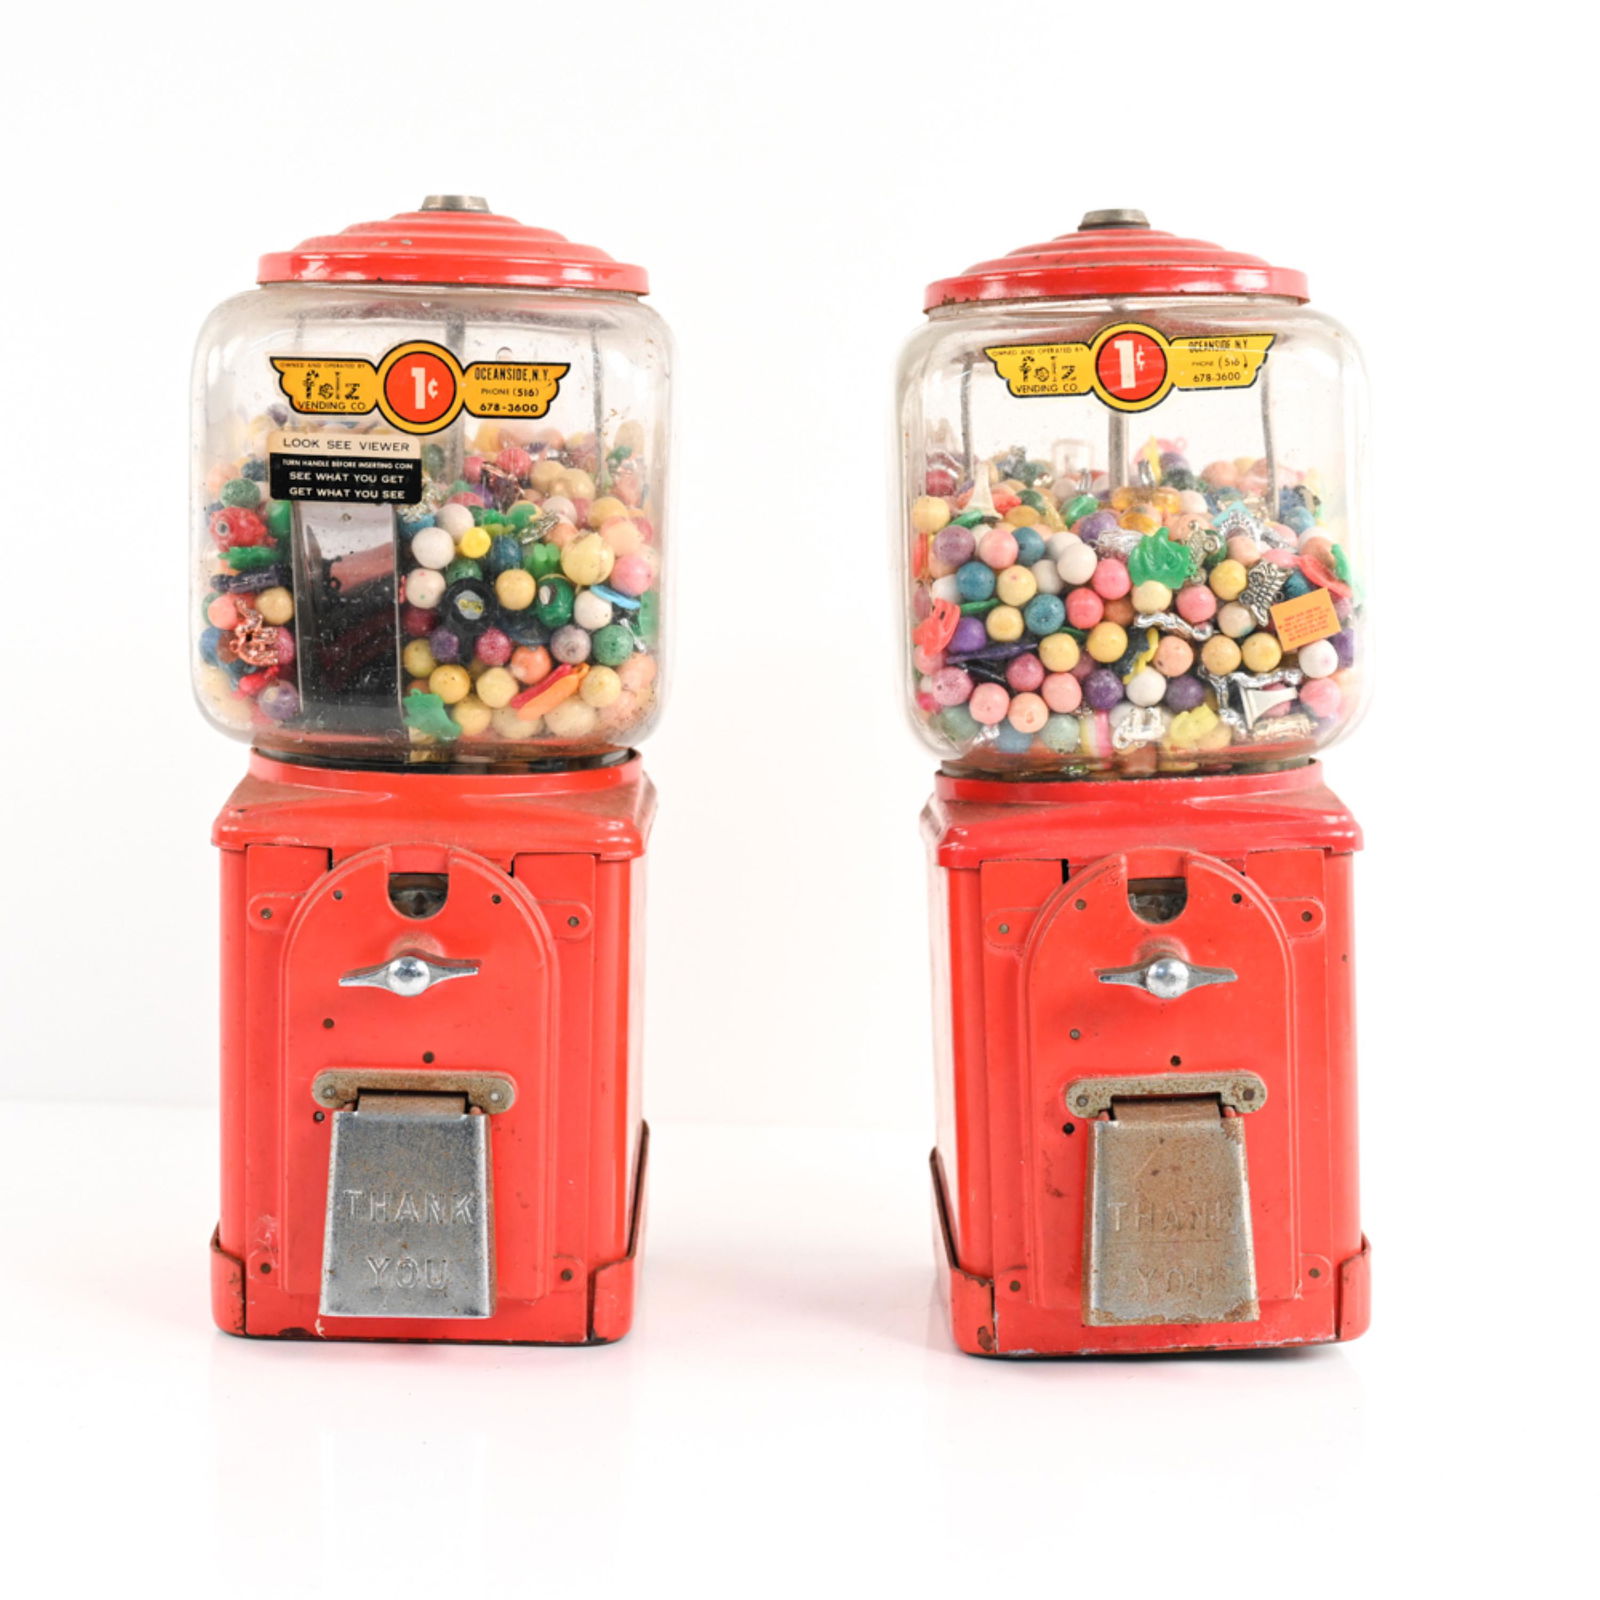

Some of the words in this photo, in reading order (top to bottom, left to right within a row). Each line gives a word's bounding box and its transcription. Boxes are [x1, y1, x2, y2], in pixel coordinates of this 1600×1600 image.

[1015, 384, 1058, 393] VENDING
[299, 401, 346, 410] VENDING
[480, 403, 539, 412] 678-3600
[283, 438, 320, 448] LOOK
[327, 440, 352, 450] SEE
[359, 441, 410, 451] VIEWER
[358, 461, 393, 469] INSERTING
[395, 462, 413, 470] COIN
[289, 471, 312, 480] SEE
[315, 472, 349, 482] WHAT
[354, 474, 377, 483] YOU
[381, 475, 405, 484] GET
[289, 487, 313, 496] GET
[316, 488, 351, 497] WHAT
[354, 489, 378, 498] YOU
[382, 490, 405, 499] SEE
[343, 1189, 478, 1225] THANK
[367, 1256, 449, 1290] YOU
